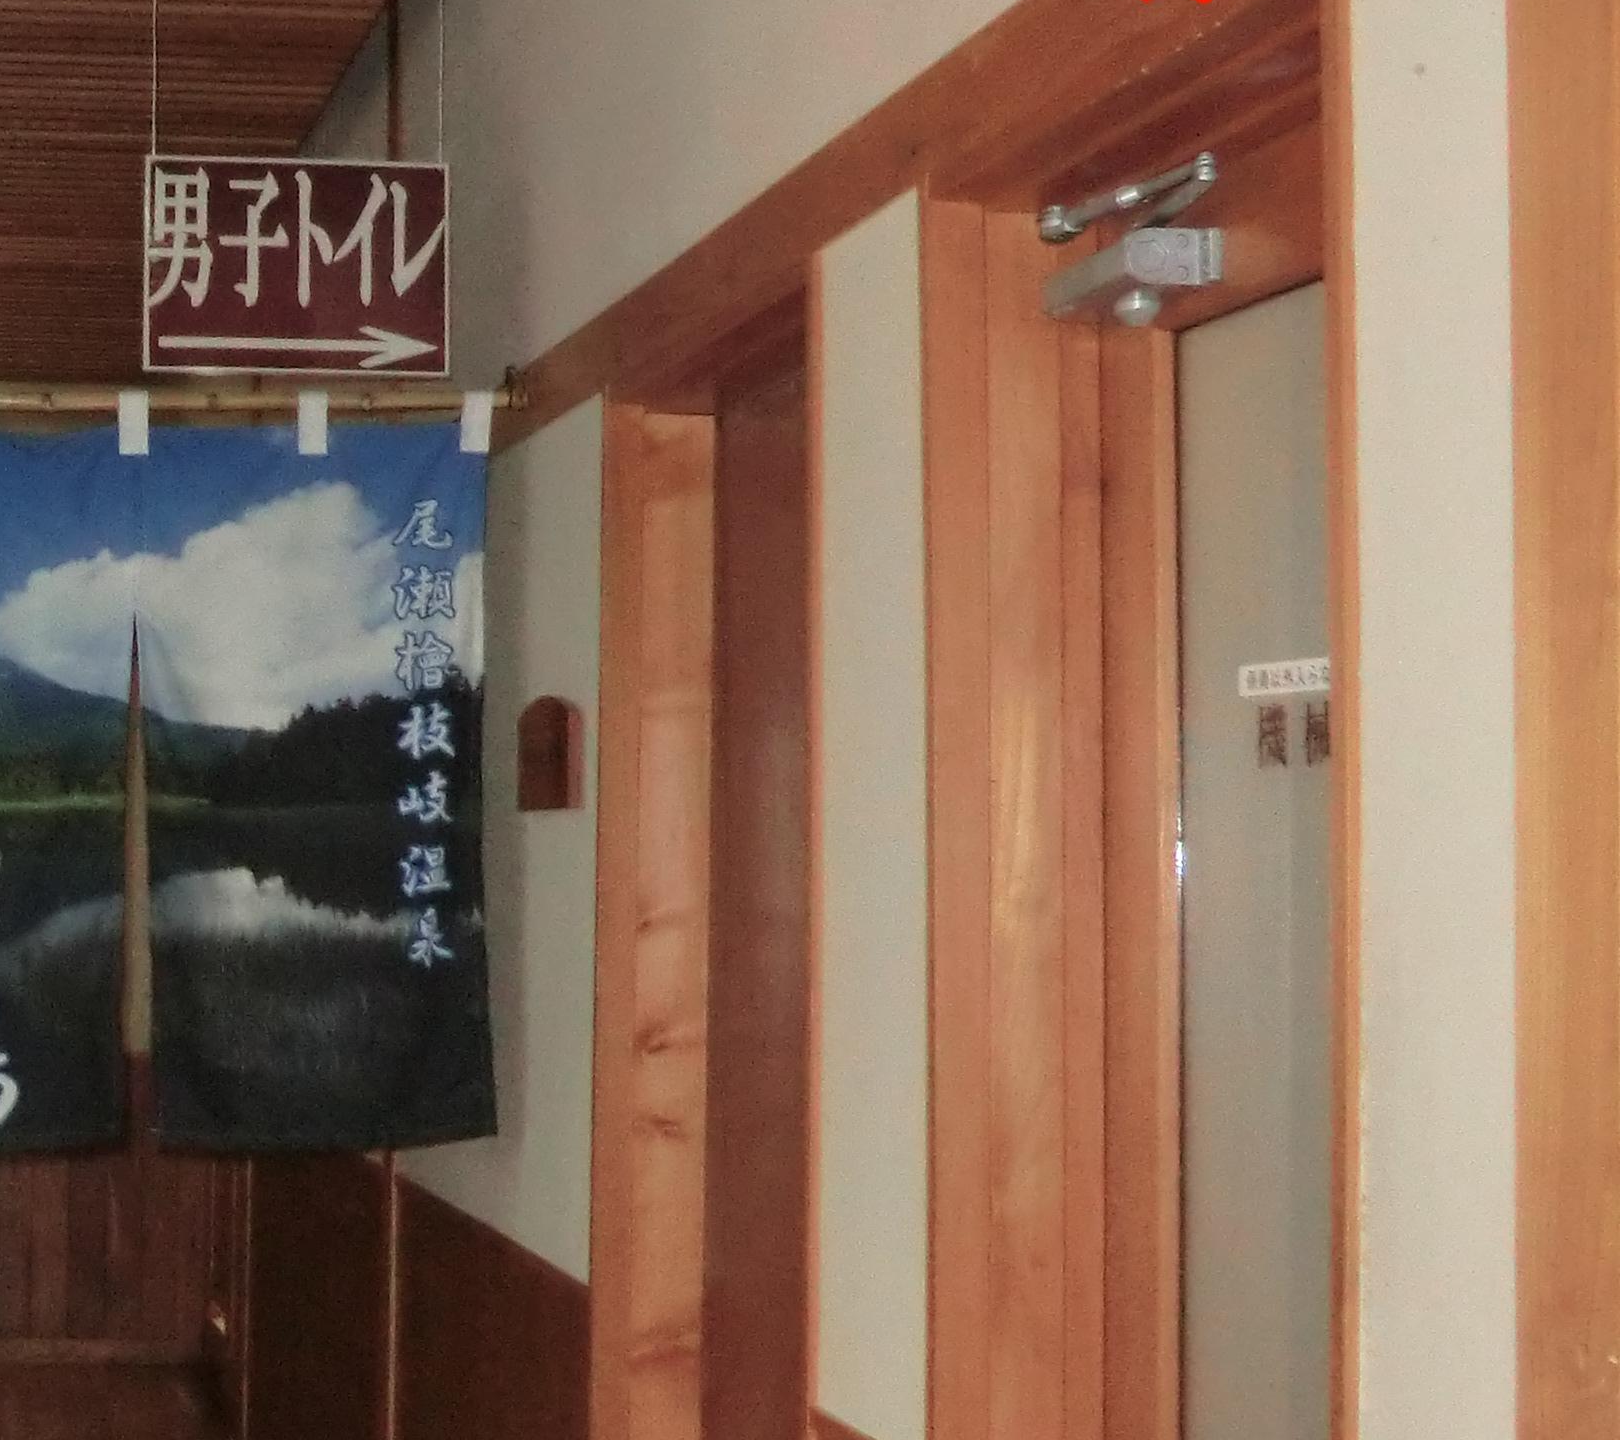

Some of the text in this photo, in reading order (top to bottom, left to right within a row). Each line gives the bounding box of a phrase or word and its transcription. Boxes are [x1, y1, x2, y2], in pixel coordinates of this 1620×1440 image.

[147, 166, 446, 308] 男子トイレ
[391, 498, 456, 969] 尾瀬檜枝岐温泉
